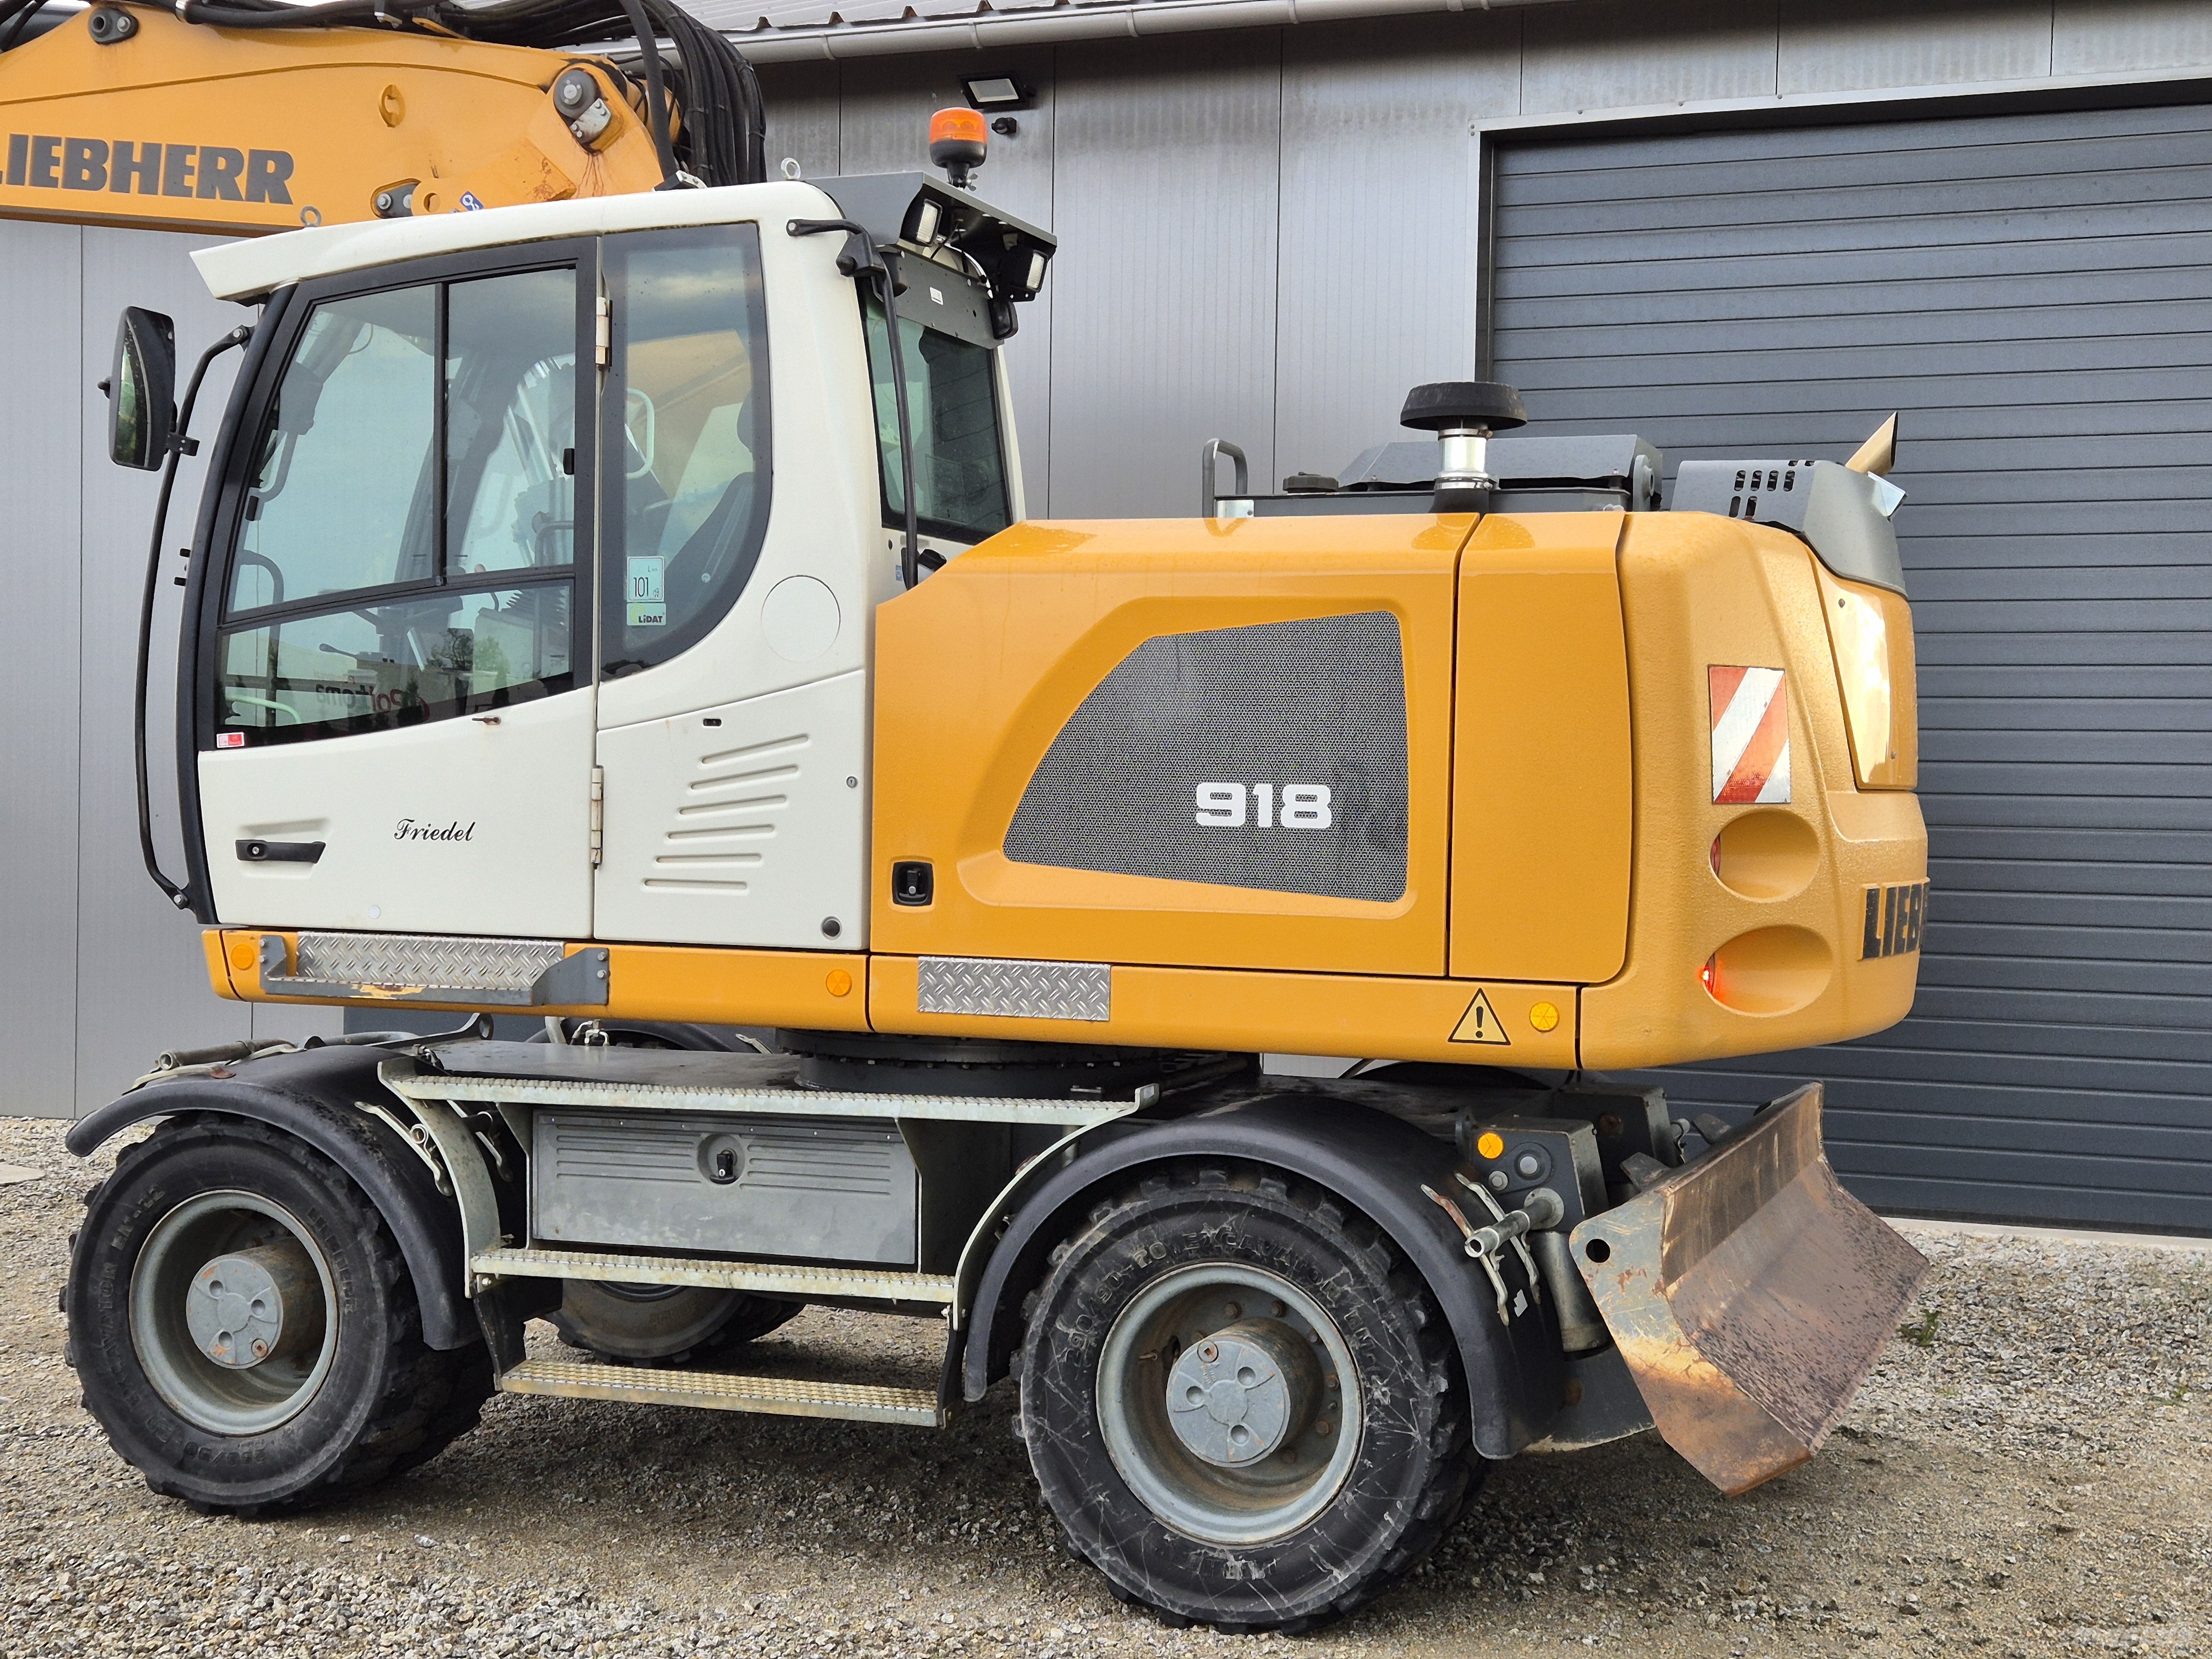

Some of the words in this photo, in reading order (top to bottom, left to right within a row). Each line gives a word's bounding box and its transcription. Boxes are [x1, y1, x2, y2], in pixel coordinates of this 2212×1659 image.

[0, 133, 294, 205] IEBHERR
[633, 577, 649, 597] 101
[1196, 782, 1332, 828] 918
[394, 818, 476, 841] Friedel
[1863, 883, 1928, 959] LIEB
